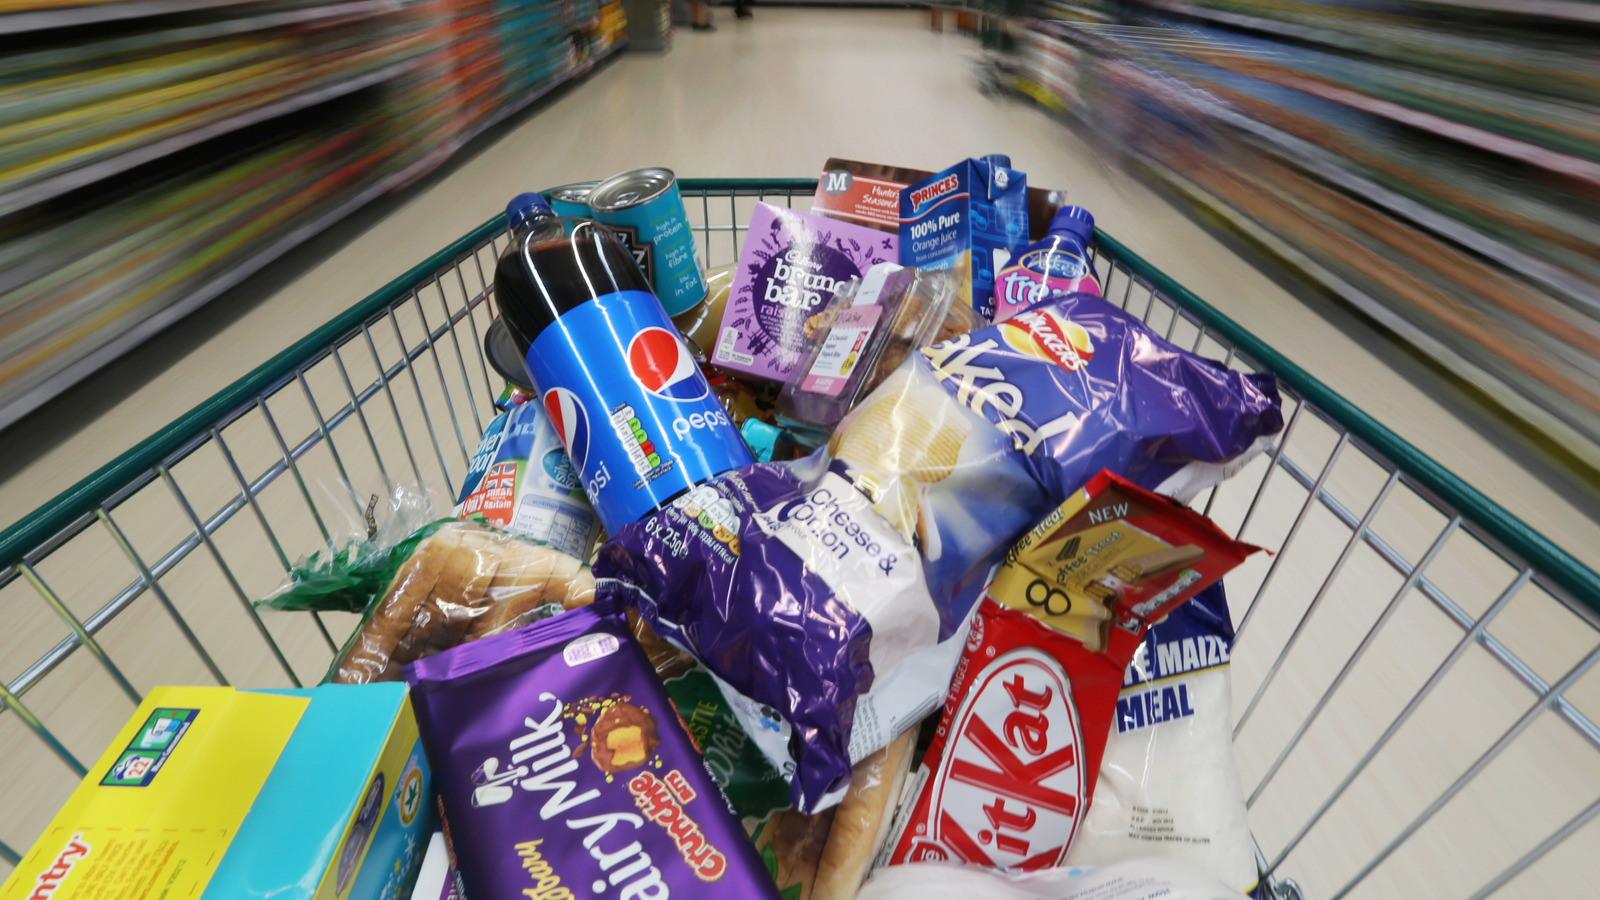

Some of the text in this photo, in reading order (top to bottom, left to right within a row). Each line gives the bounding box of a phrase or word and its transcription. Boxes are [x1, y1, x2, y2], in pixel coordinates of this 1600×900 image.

[826, 173, 847, 191] M
[910, 174, 959, 213] PRINCES
[862, 194, 899, 208] Seasoned
[653, 222, 683, 246] protein
[656, 221, 669, 232] high
[910, 212, 960, 240] 100% Pure
[912, 229, 957, 252] Orange Juice
[668, 252, 688, 268] fibre
[685, 277, 698, 290] fat
[764, 277, 822, 311] bar
[1004, 272, 1063, 305] tre
[920, 333, 1080, 456] aked
[672, 409, 730, 441] pepsi
[554, 452, 570, 481] silve
[587, 460, 611, 506] psi
[645, 516, 657, 533] 6
[651, 524, 662, 539] x
[785, 517, 808, 540] avour
[1032, 505, 1065, 540] Treat
[1088, 502, 1129, 525] NEW
[794, 504, 850, 560] Onion
[811, 489, 882, 558] Cheese
[878, 553, 898, 576] &
[1056, 554, 1088, 585] offee
[1083, 530, 1124, 558] Treat
[1025, 578, 1071, 616] 8
[1156, 635, 1231, 677] MAIZE
[948, 656, 970, 702] FINGER
[689, 700, 718, 751] ASTIE
[944, 703, 954, 715] 2
[1116, 683, 1194, 734] MEAL
[936, 725, 946, 737] 8
[510, 692, 601, 820] Milk
[703, 712, 748, 788] Whit
[128, 760, 150, 778] 22
[627, 770, 727, 881] Crunchie
[29, 842, 88, 900] ntry
[514, 838, 575, 900] dbury
[566, 812, 669, 900] airy
